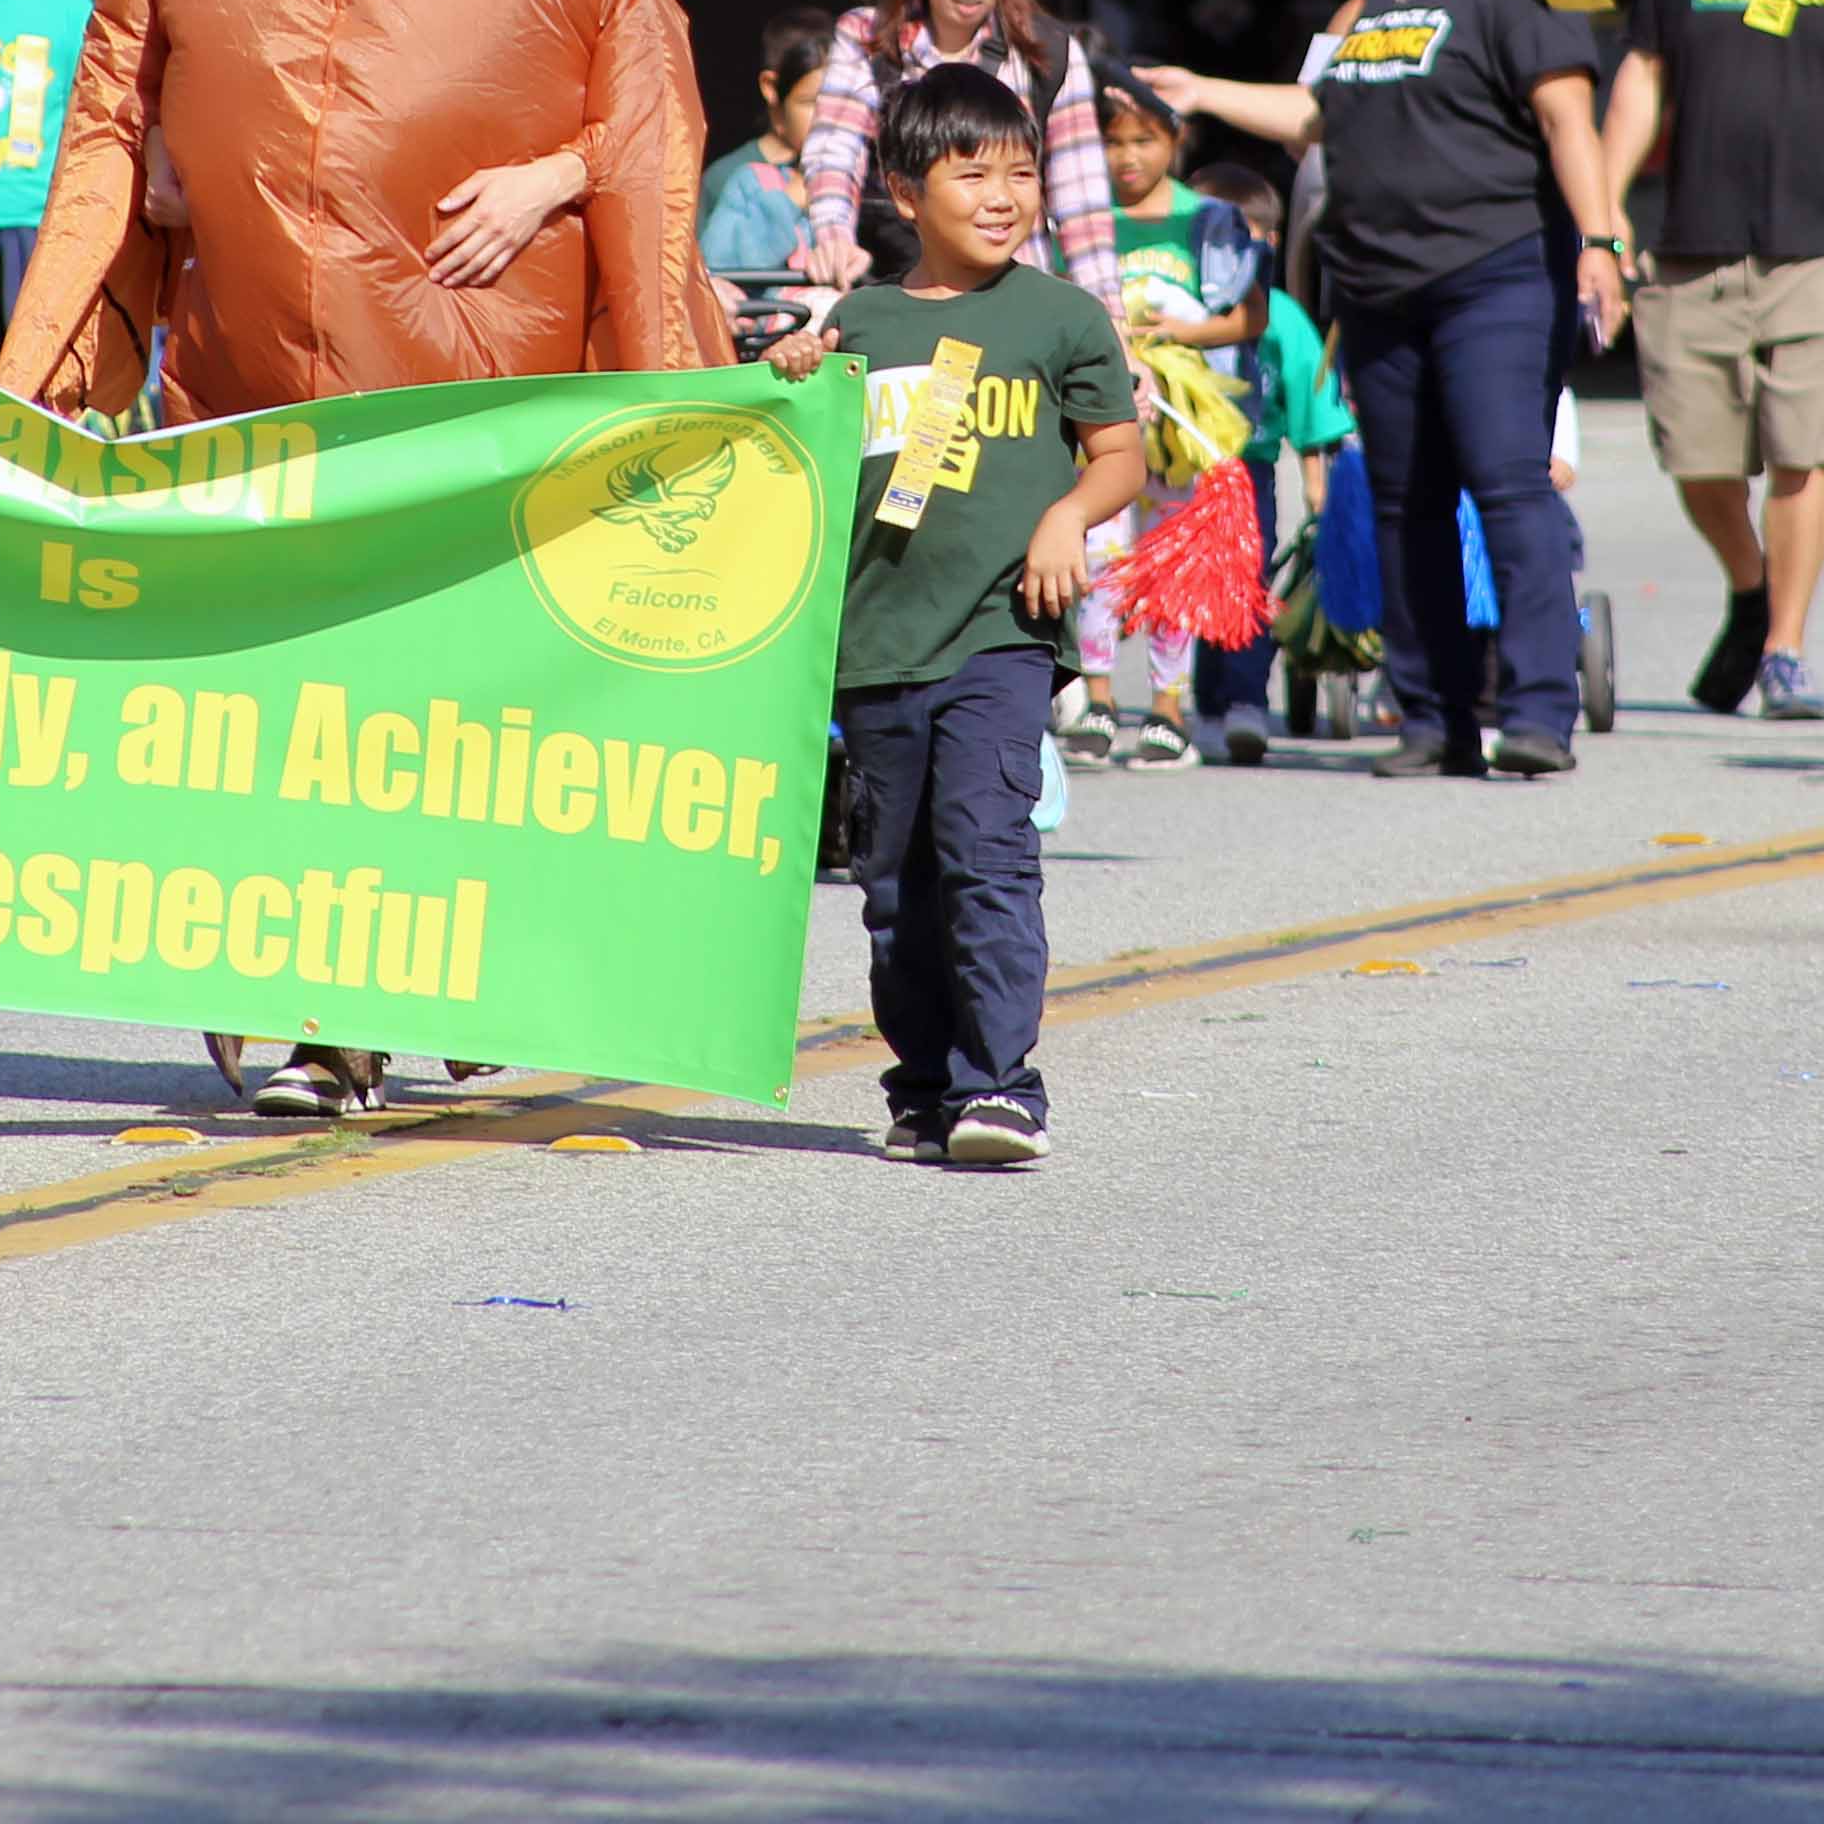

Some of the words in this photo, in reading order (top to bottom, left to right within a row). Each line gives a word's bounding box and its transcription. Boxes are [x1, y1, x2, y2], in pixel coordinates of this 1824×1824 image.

[654, 416, 798, 476] Elementary
[39, 539, 141, 610] Is
[608, 581, 720, 613] Falcons
[591, 616, 615, 638] El
[617, 628, 690, 654] Monte,
[696, 628, 728, 650] CA
[118, 681, 263, 791] an
[280, 679, 782, 877] Achiever,
